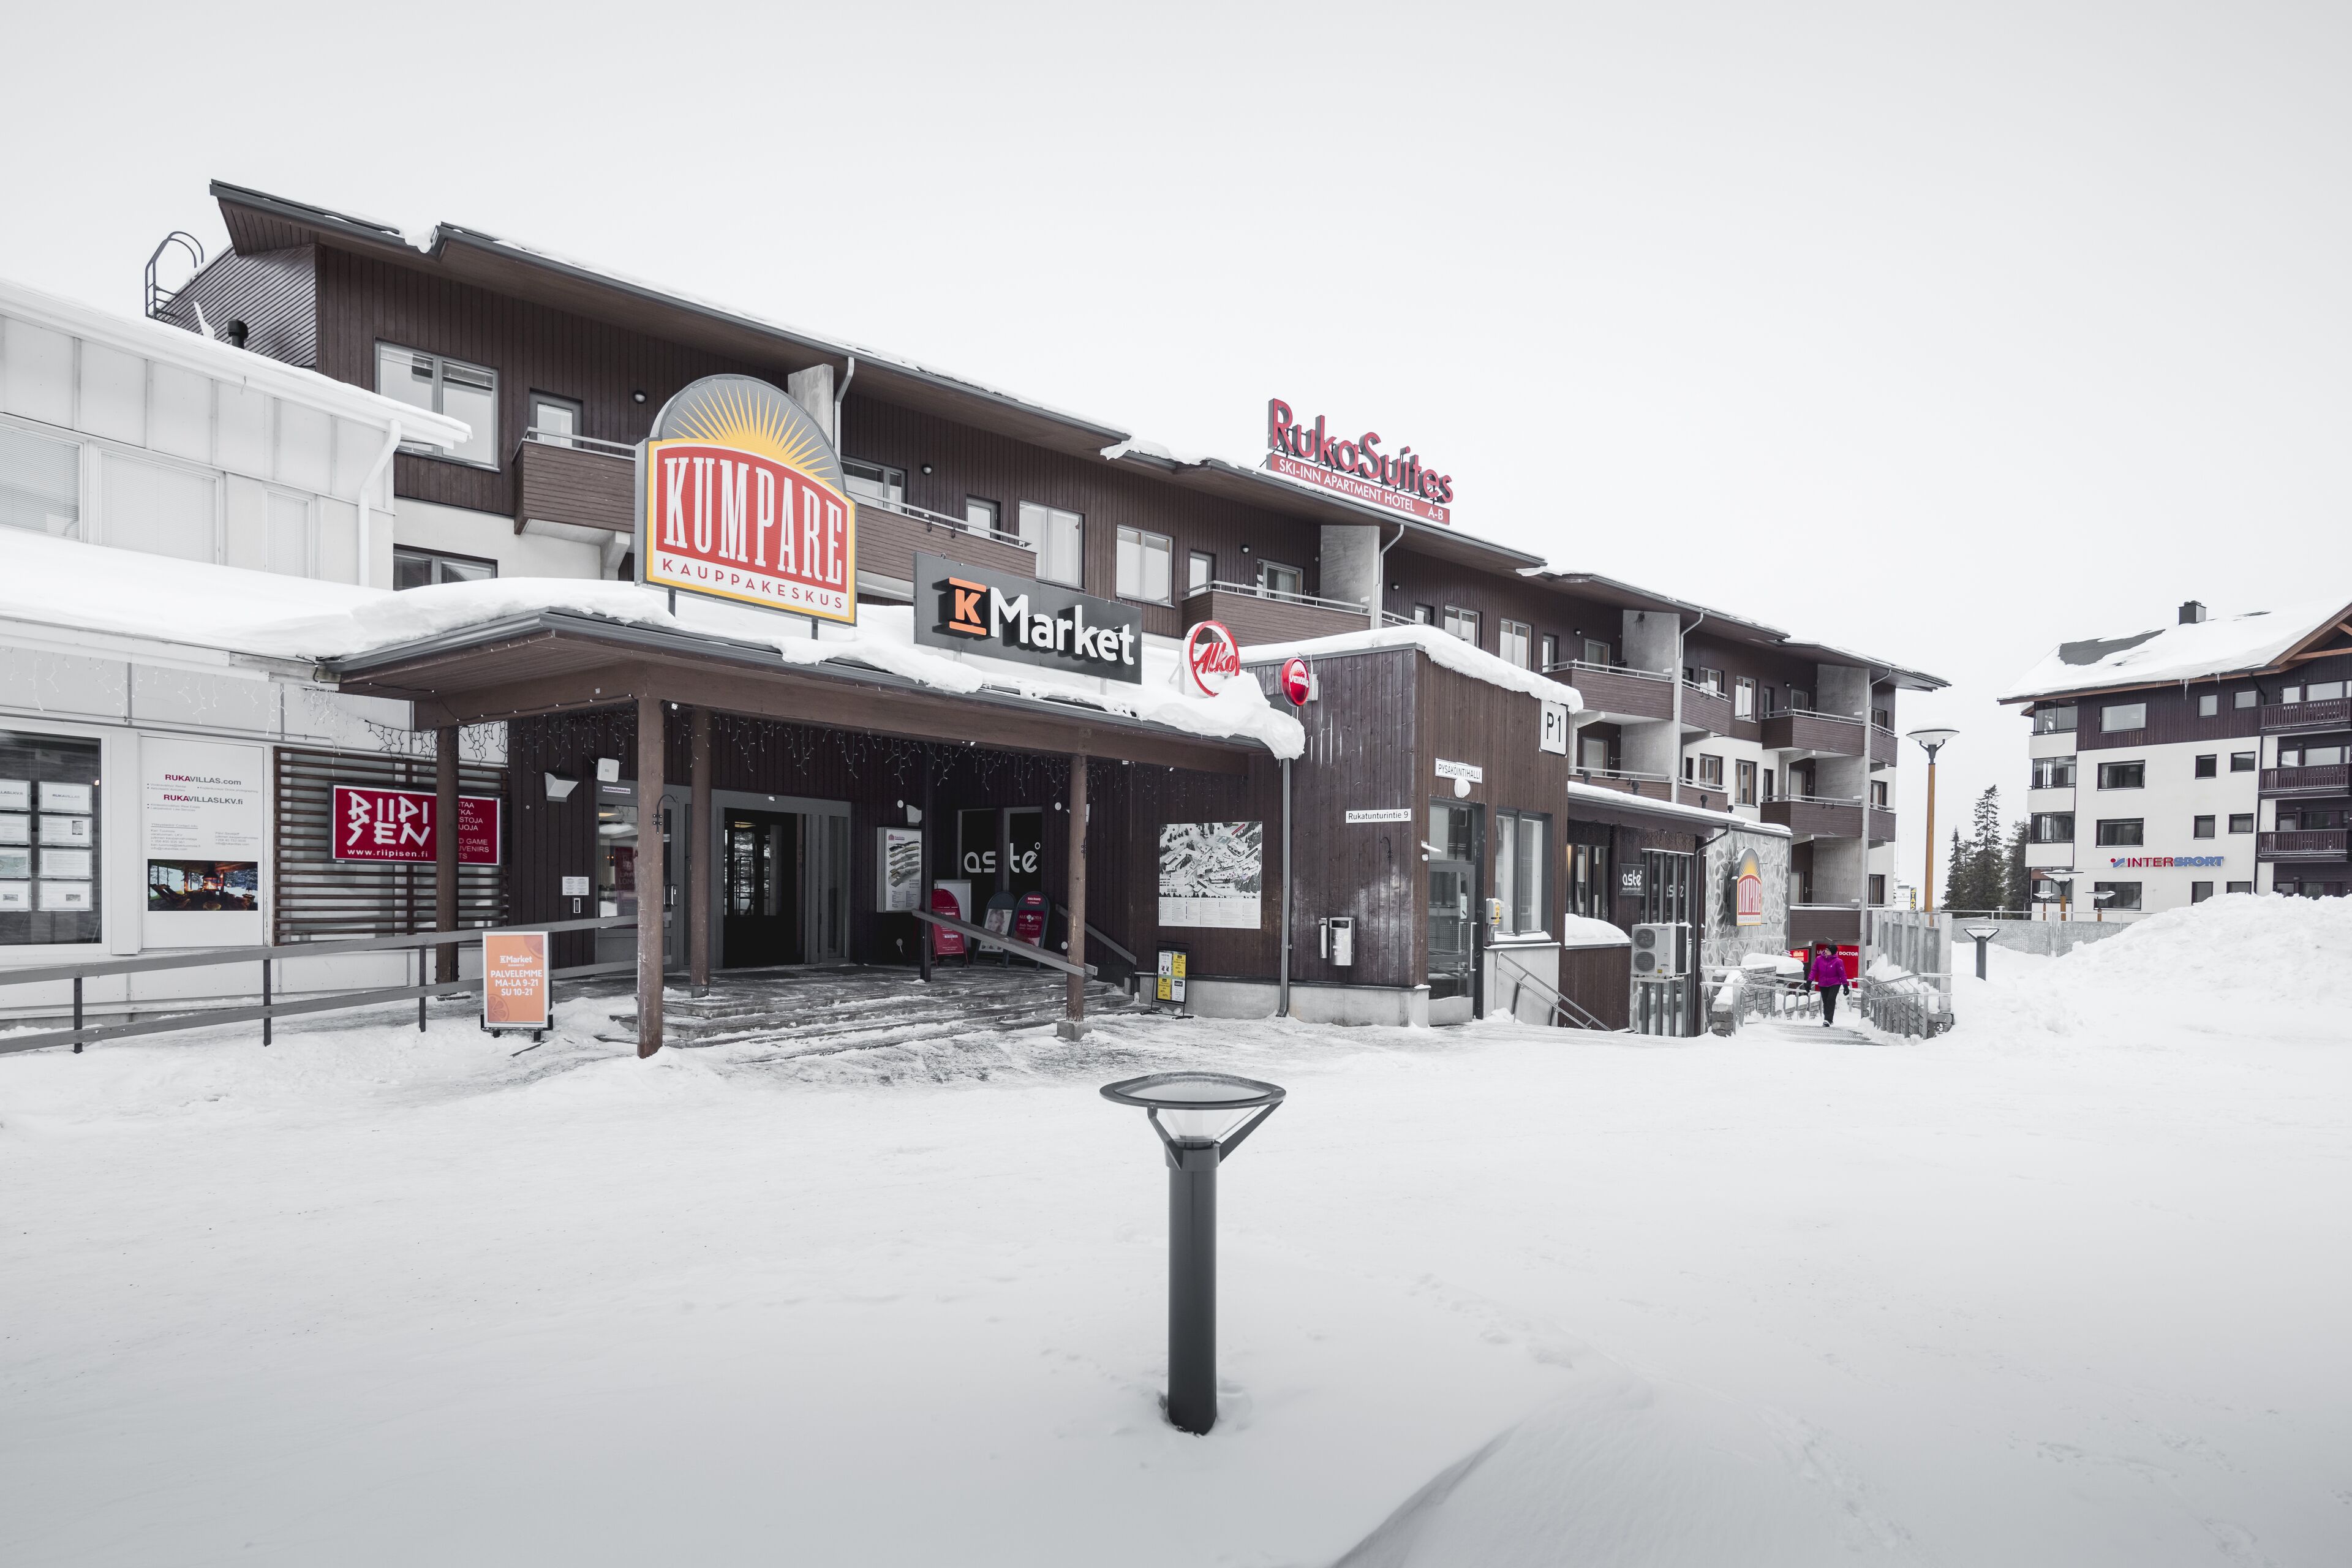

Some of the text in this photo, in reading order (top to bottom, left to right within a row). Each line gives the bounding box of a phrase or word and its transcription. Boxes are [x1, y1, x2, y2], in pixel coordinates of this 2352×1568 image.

[1268, 398, 1453, 503] RukaSuites
[1279, 459, 1444, 521] SKI-INN APARTMENT HOTEL A-B
[663, 457, 842, 586] KUMPARE
[663, 558, 842, 609] KAUPPAKESKUS
[1193, 641, 1236, 674] Alko
[1547, 712, 1561, 743] P1
[165, 774, 241, 785] RUKAVILLAS.com
[1438, 763, 1480, 779] PYSÄKÖINTIHALLI
[164, 794, 243, 804] RUKAVILLASLKV.fi
[1348, 812, 1401, 820] Rukatunturintie
[2127, 856, 2225, 868] INTERSPORT
[1739, 878, 1761, 913] KUMPARE
